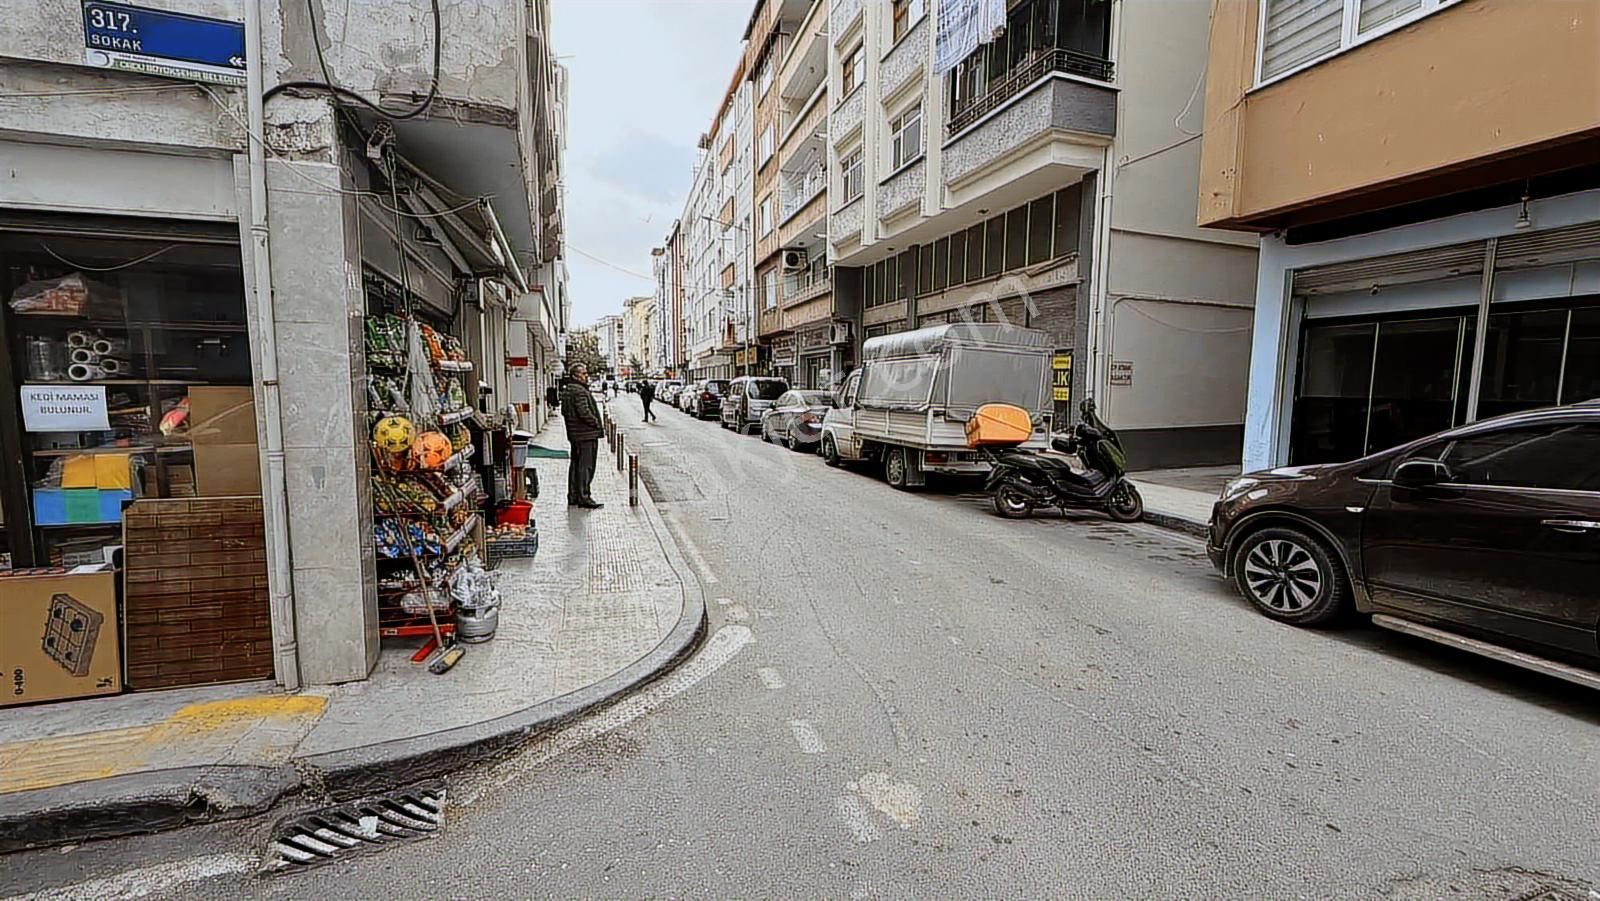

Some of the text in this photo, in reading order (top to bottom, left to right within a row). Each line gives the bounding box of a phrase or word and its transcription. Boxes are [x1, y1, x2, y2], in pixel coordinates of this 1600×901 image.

[91, 9, 138, 34] 317.
[91, 34, 142, 51] SOKAK
[30, 392, 54, 401] KEDİ
